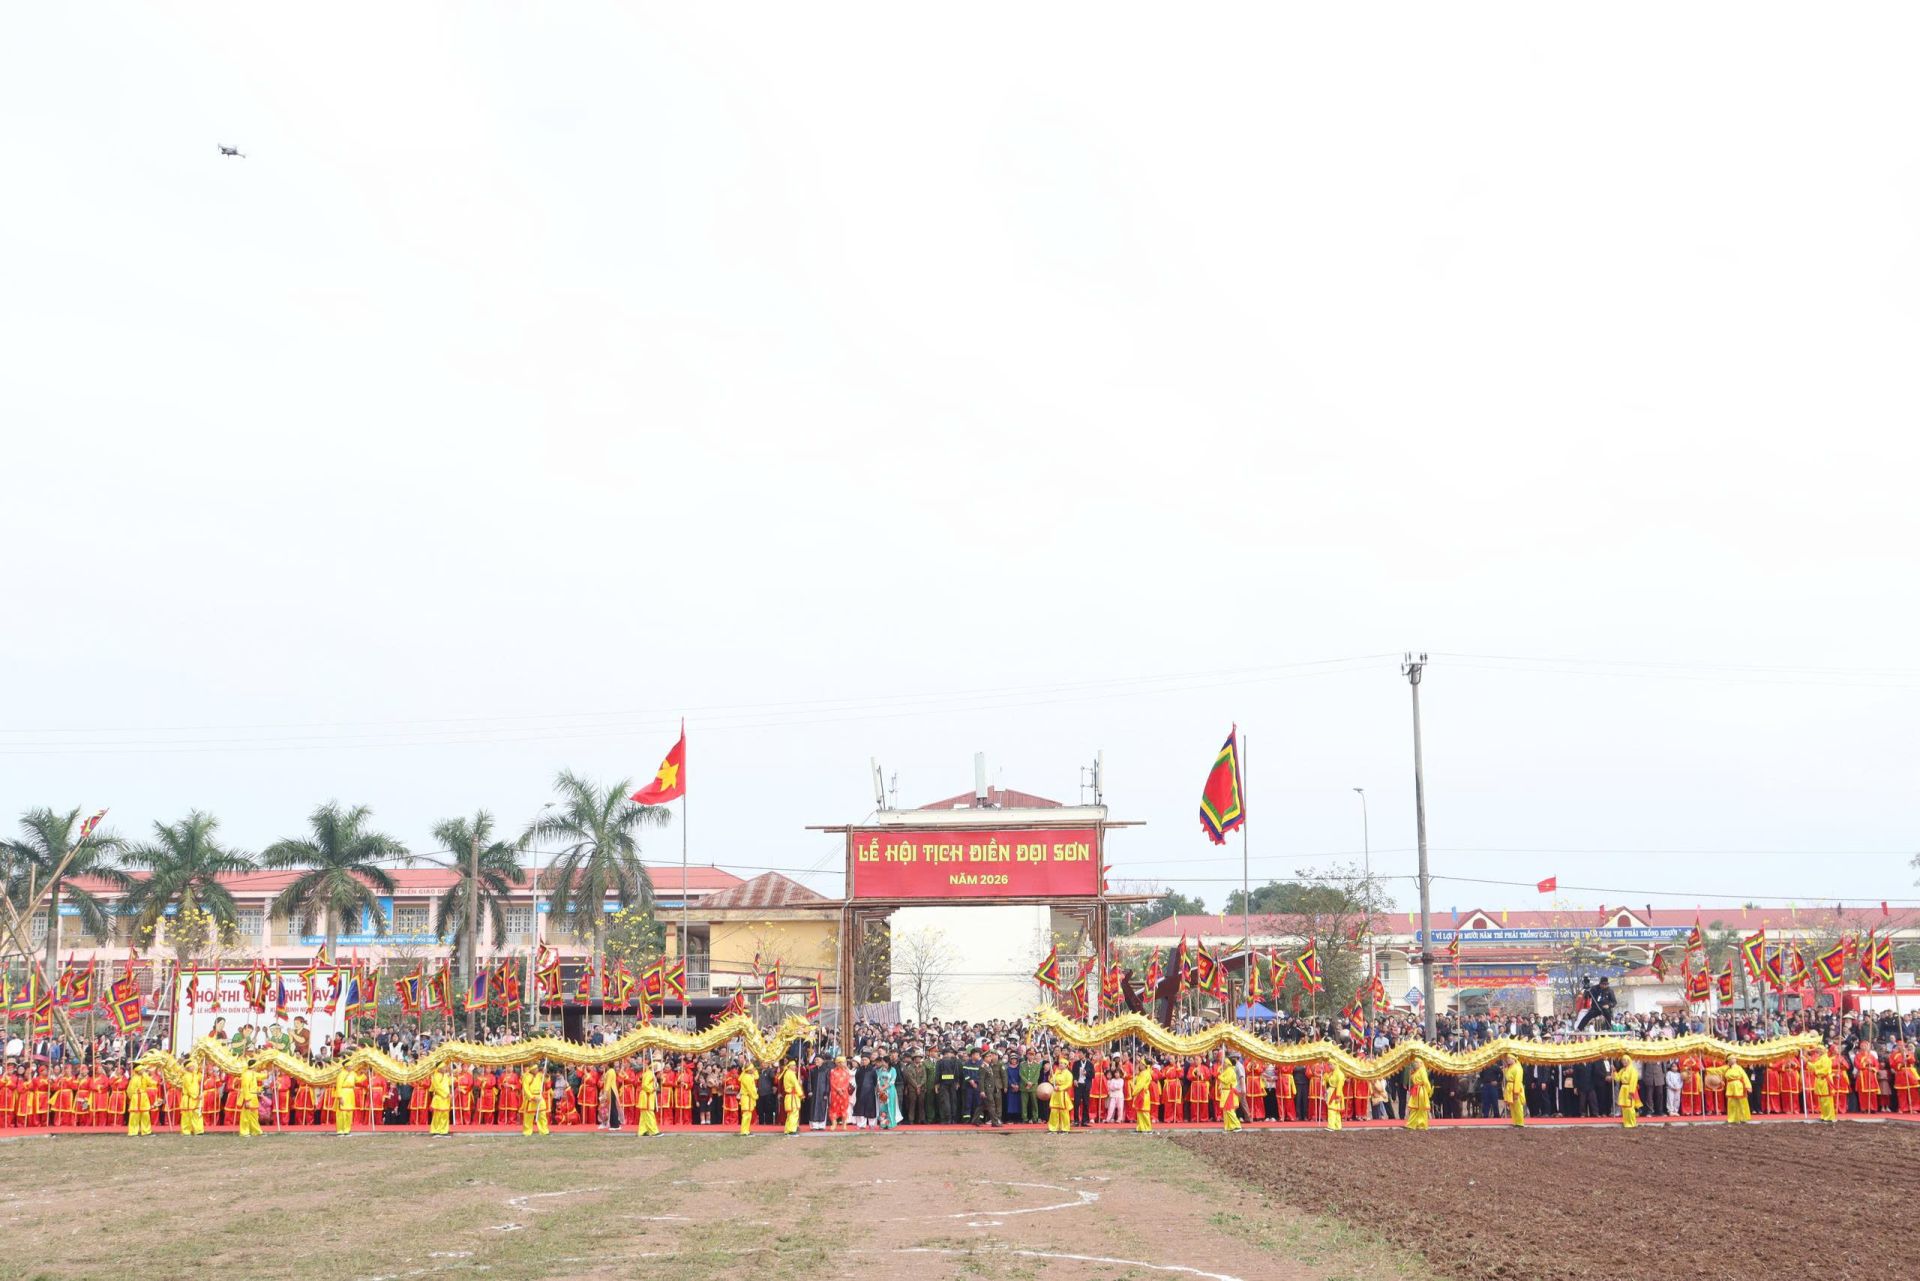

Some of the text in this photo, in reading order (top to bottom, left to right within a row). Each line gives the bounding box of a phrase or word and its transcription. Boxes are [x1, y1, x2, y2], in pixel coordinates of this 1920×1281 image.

[858, 837, 1090, 866] LỄ HỘI TỊCH ĐIỀN ĐỌI SƠN
[949, 872, 1009, 885] NĂM 2026
[221, 990, 240, 1002] THI
[268, 989, 302, 1002] BNH
